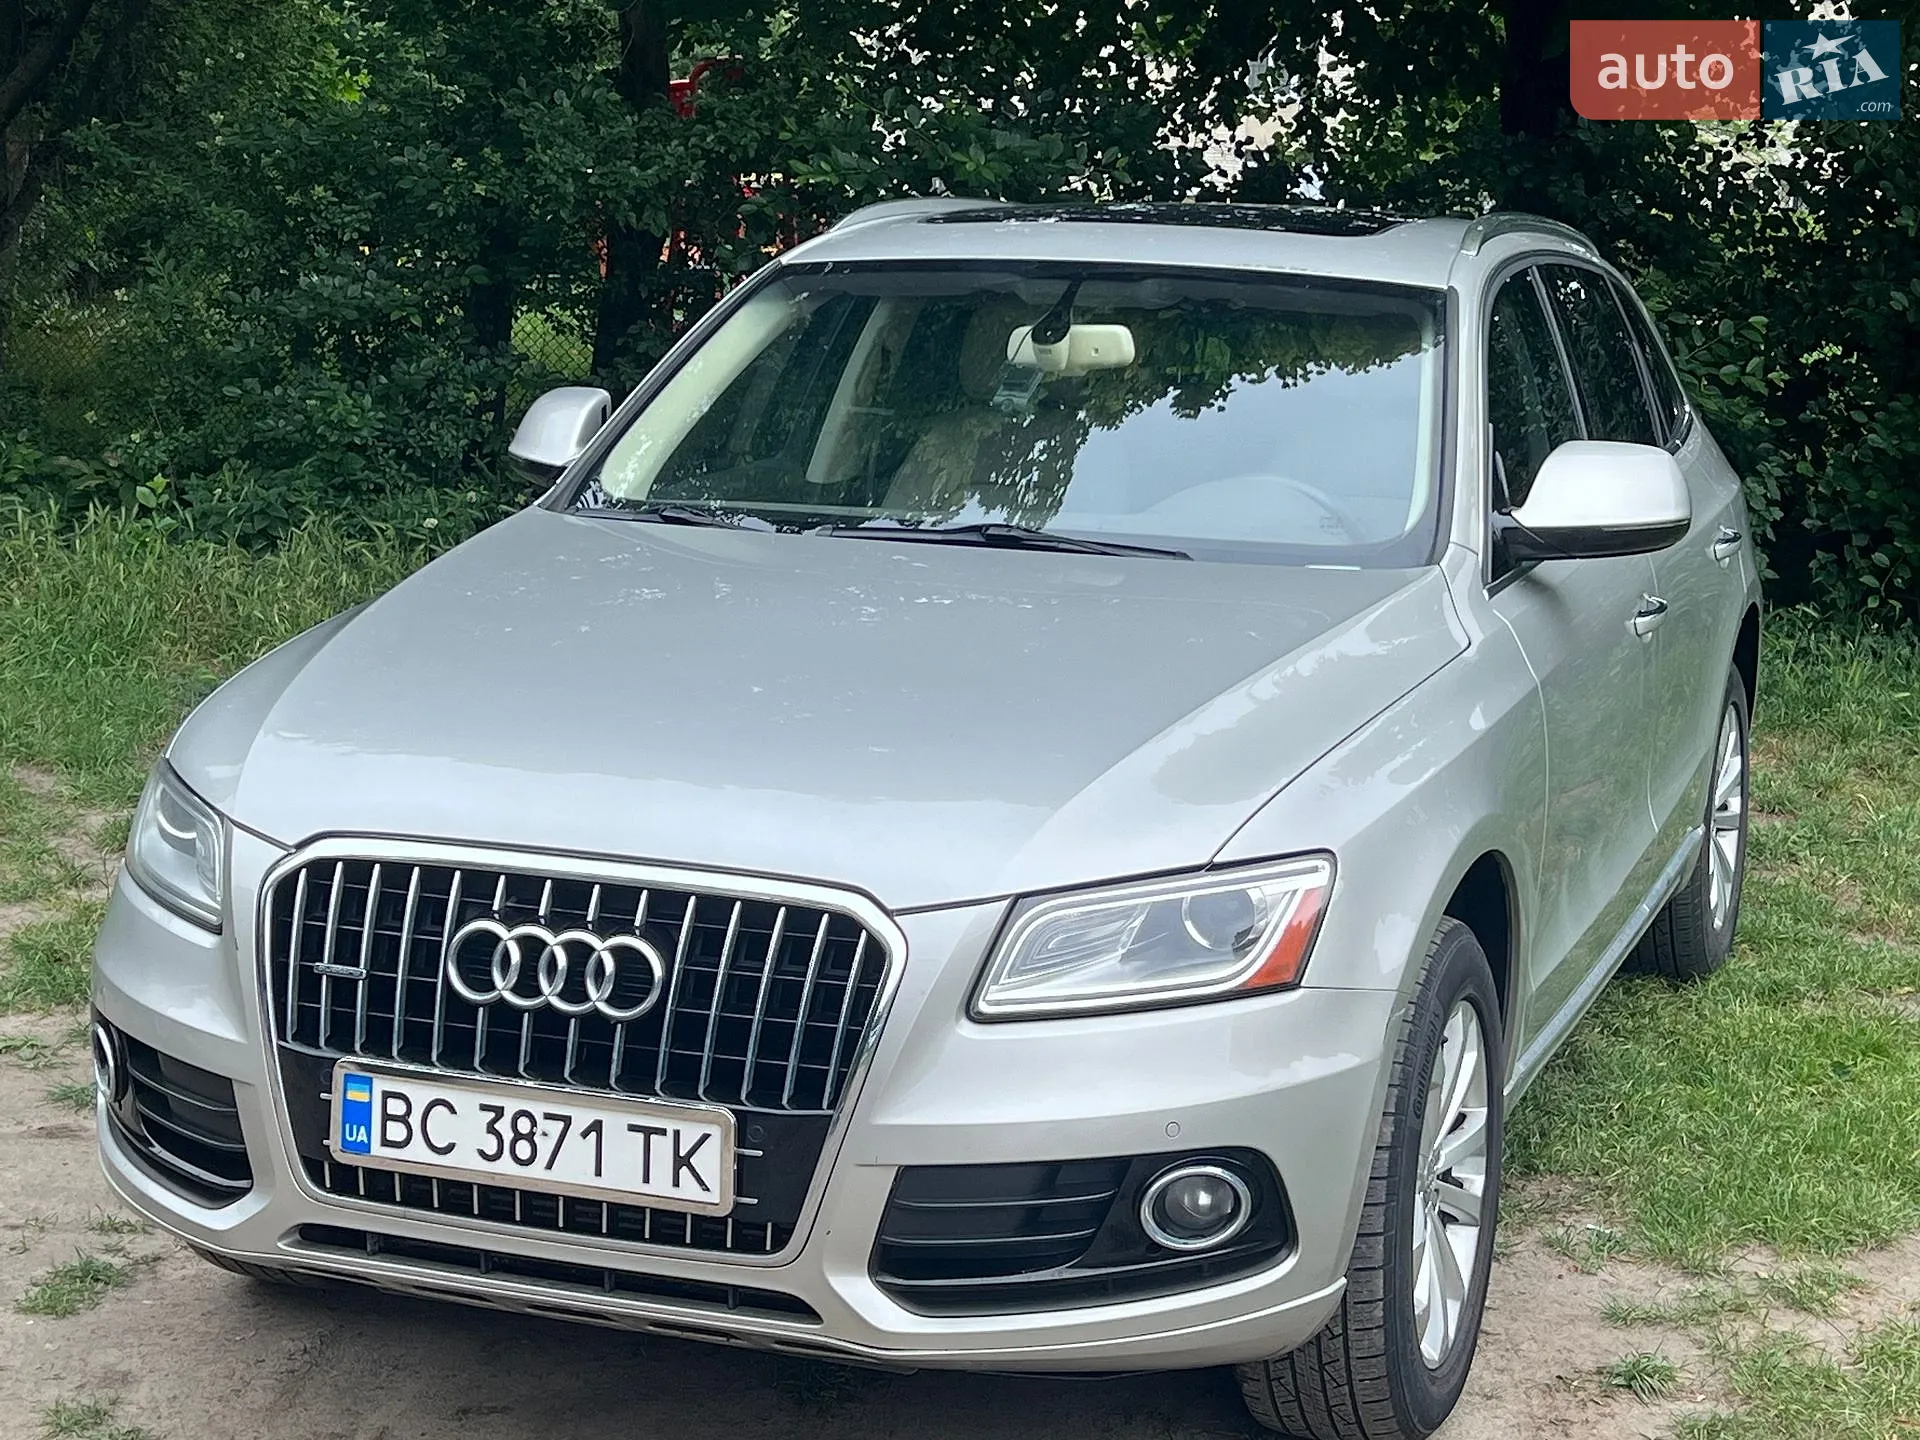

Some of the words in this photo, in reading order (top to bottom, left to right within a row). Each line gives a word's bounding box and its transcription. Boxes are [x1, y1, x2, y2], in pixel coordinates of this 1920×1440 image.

[345, 1123, 369, 1145] UA
[380, 1089, 458, 1156] BC
[476, 1102, 603, 1178] 3871
[627, 1122, 713, 1193] TK
